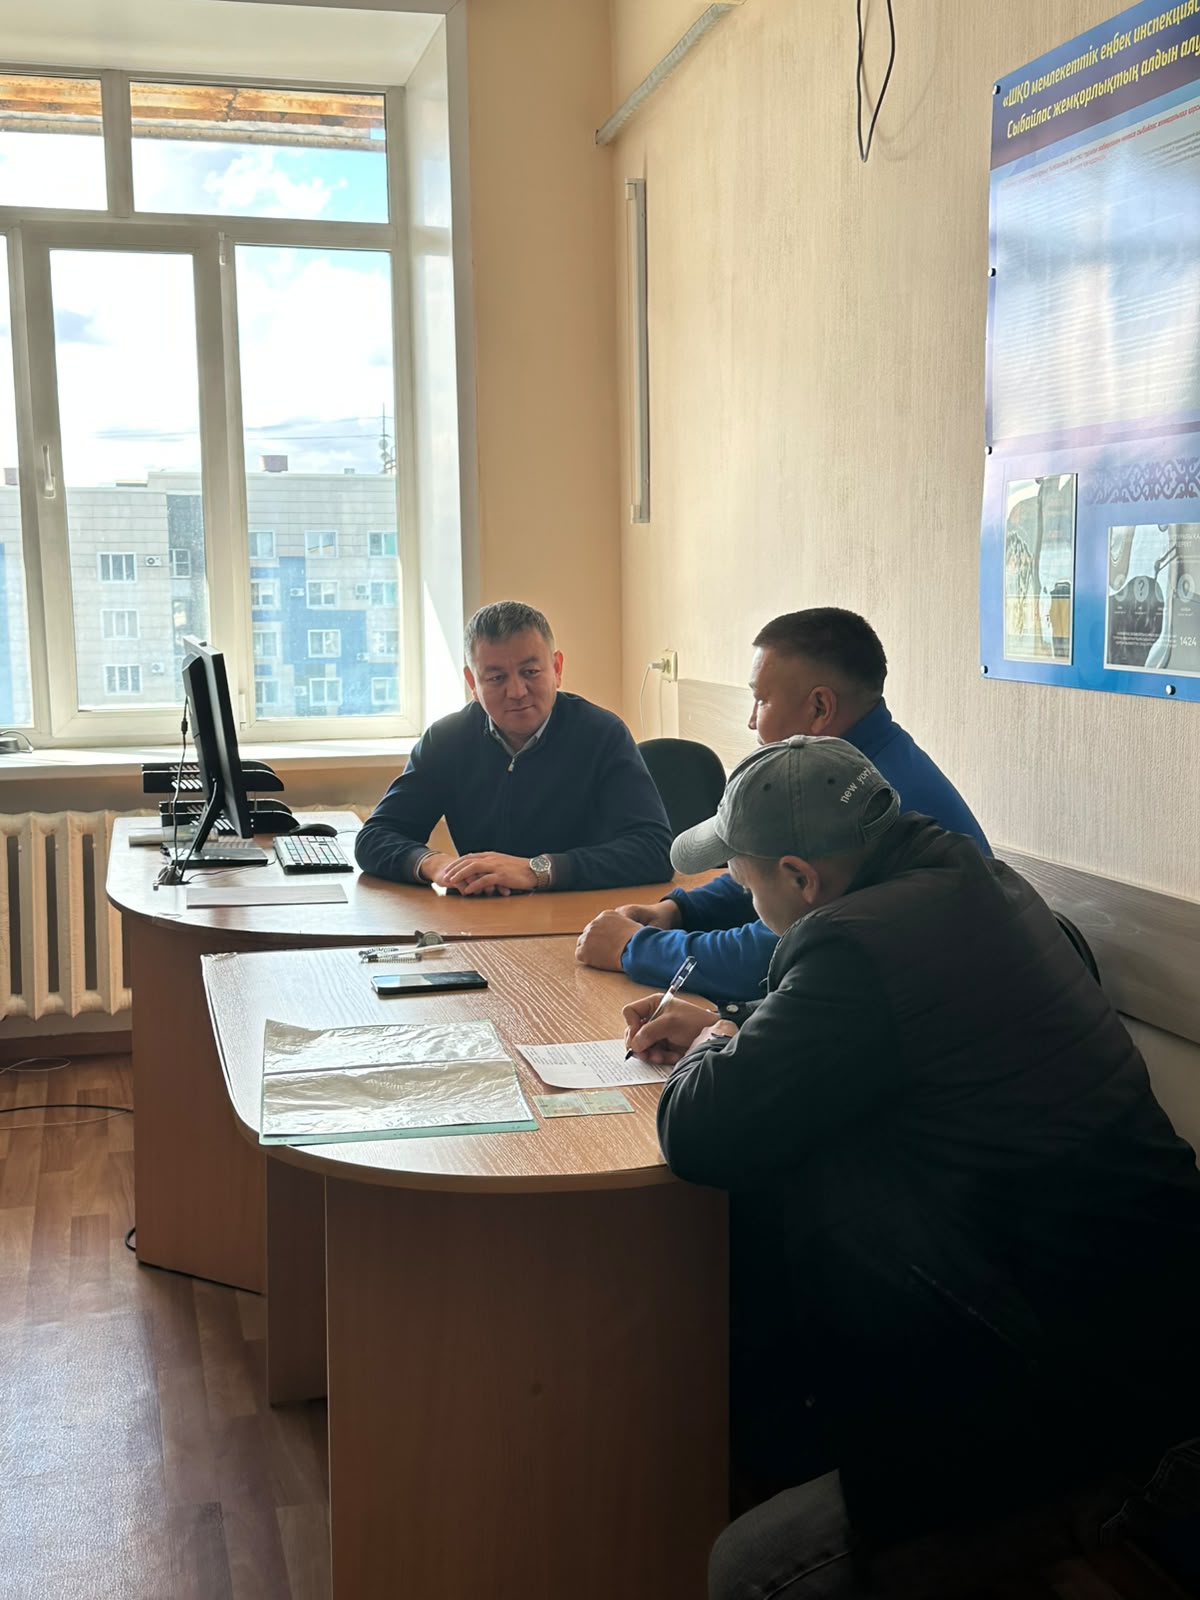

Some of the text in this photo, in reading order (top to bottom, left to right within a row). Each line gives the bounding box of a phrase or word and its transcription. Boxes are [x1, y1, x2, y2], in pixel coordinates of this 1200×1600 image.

[1003, 80, 1031, 108] «ШҚО
[1031, 45, 1099, 96] мемлекеттік
[1100, 31, 1132, 61] еңбек
[1007, 107, 1052, 139] Сыбайлас
[1053, 64, 1139, 117] жемқорлықтың
[1140, 45, 1178, 77] алдын
[1179, 636, 1197, 647] 1424
[840, 782, 858, 804] new
